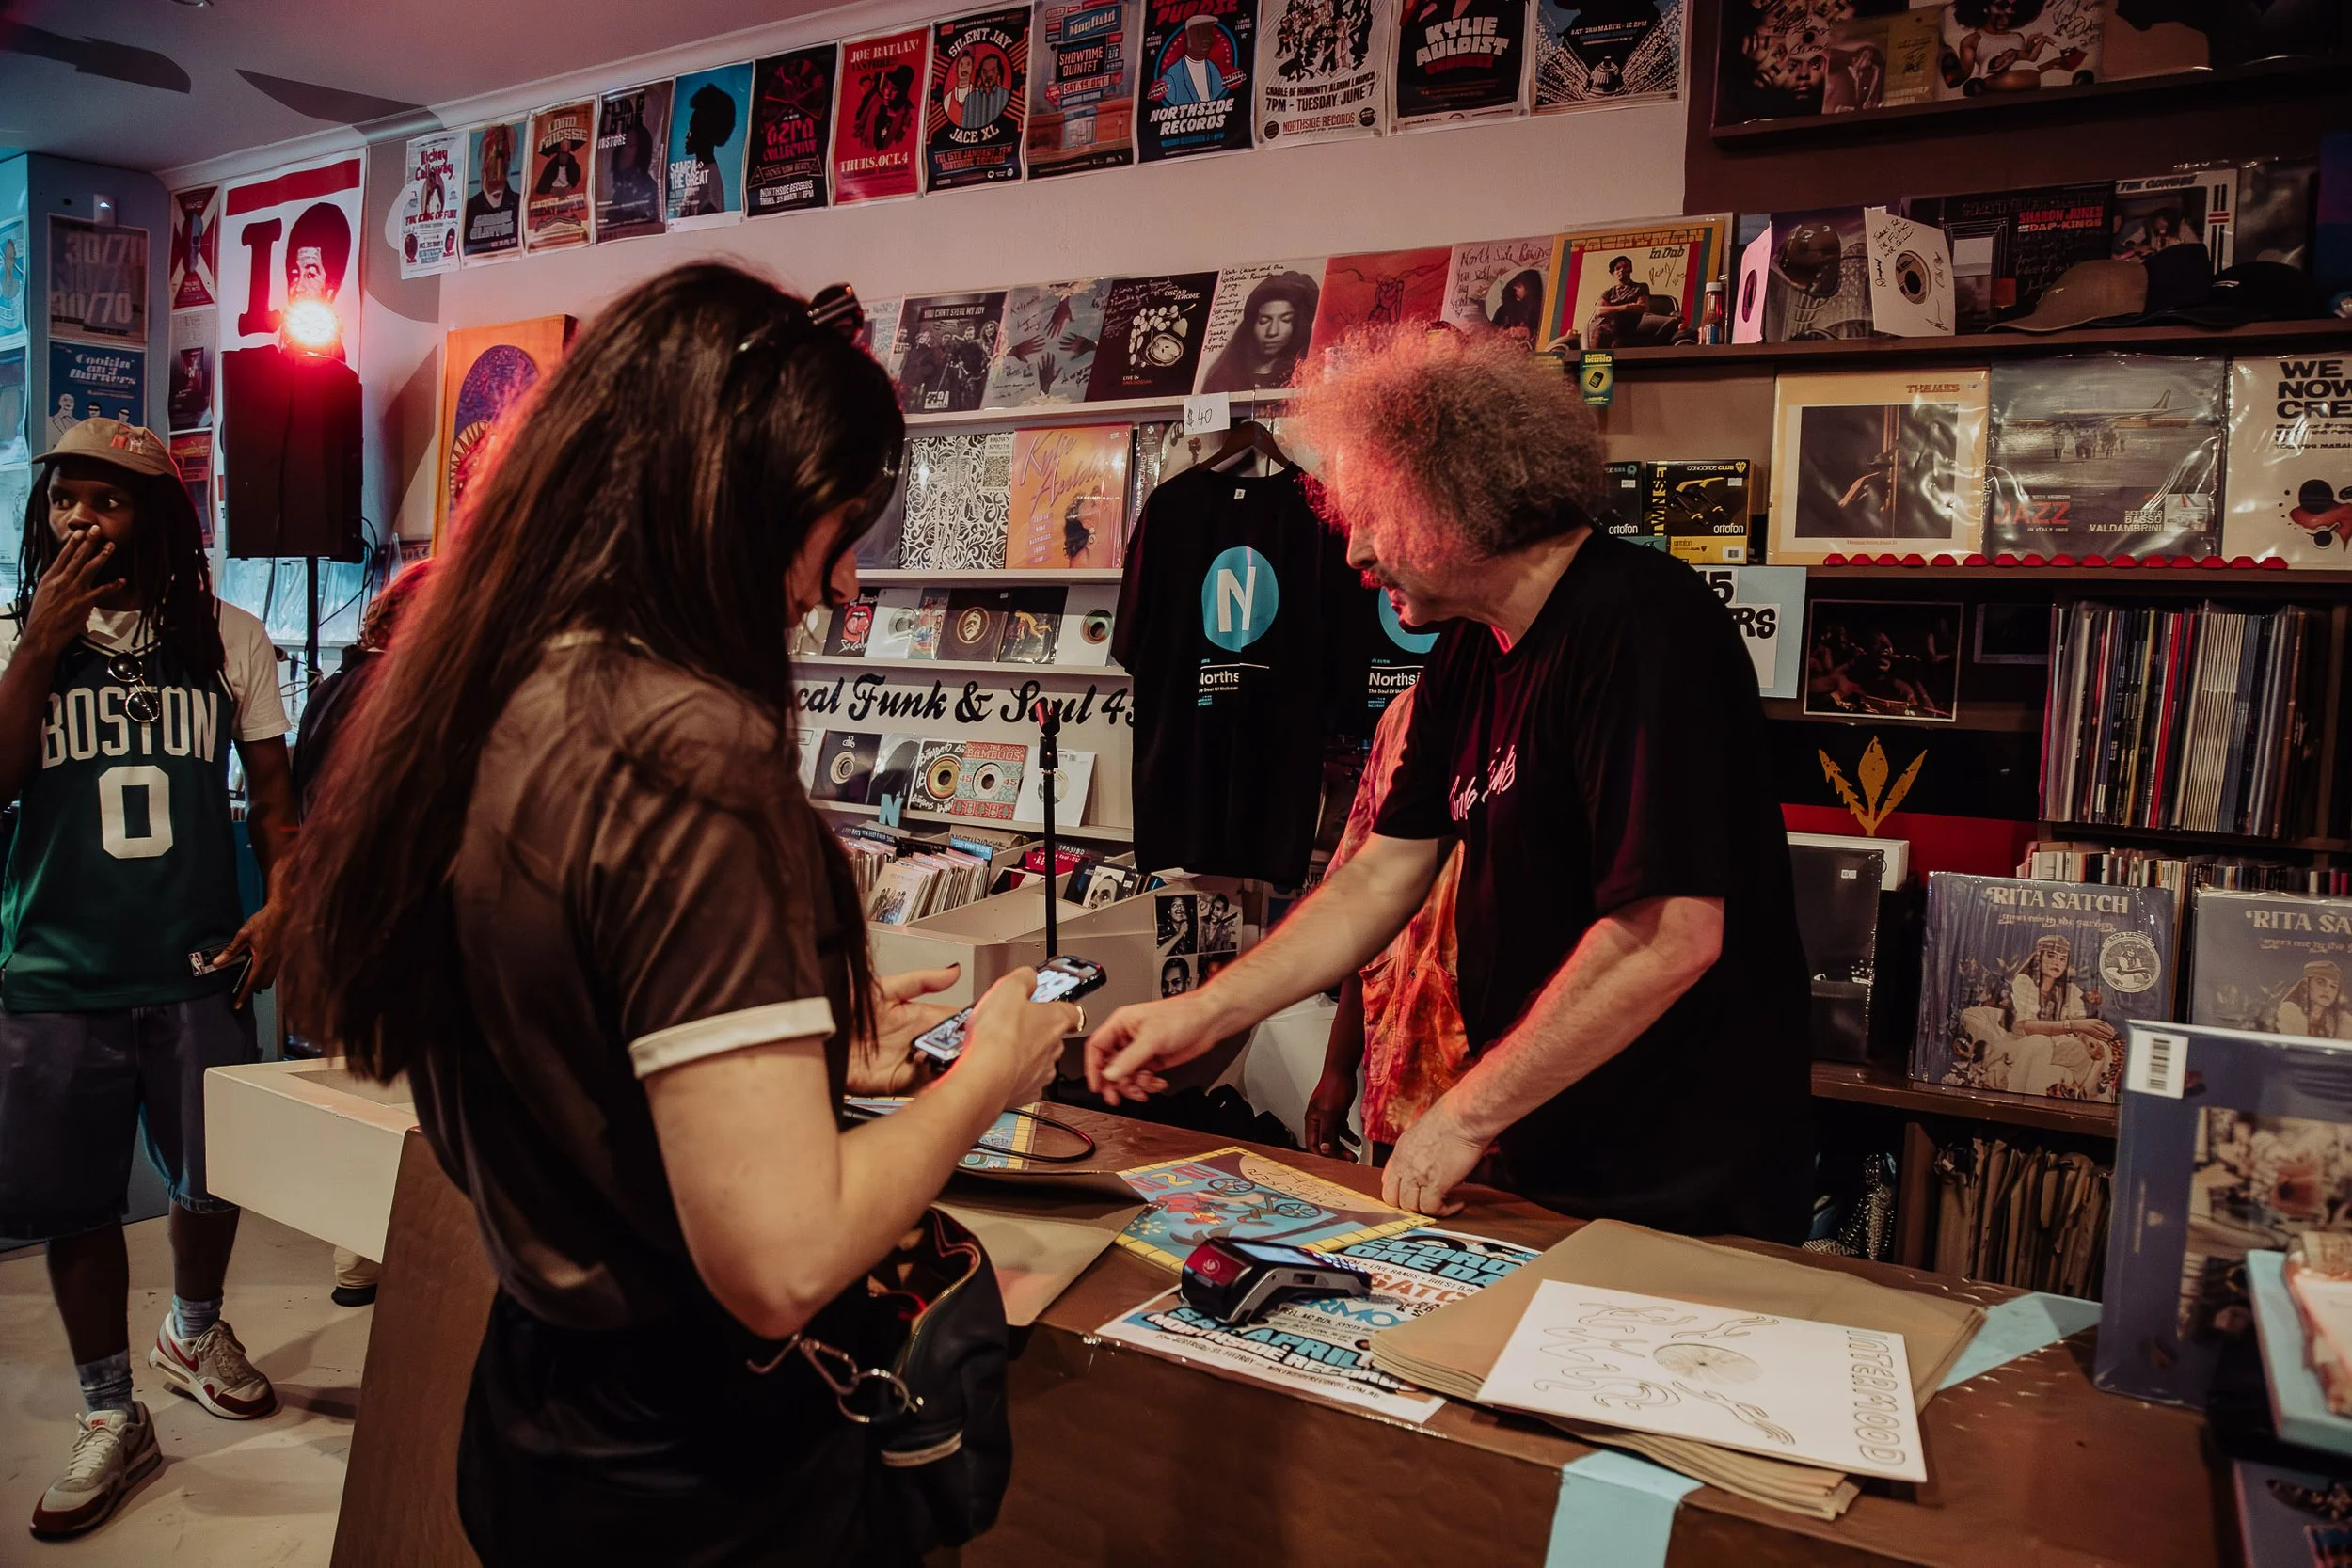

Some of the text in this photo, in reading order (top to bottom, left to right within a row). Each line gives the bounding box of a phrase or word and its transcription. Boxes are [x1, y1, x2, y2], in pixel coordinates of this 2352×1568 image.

[1425, 16, 1498, 45] KYLIE
[948, 27, 1013, 57] SILENT JAY
[1416, 36, 1509, 67] AULDIST
[850, 47, 870, 64] JOE
[1059, 46, 1104, 66] SHOWTIME
[1062, 60, 1099, 77] QUINTET
[1265, 97, 1286, 112] 7PM
[1296, 94, 1339, 112] TUESDAY
[1340, 86, 1365, 105] JUNE
[1367, 82, 1375, 96] 7
[1328, 80, 1350, 94] ALBUM
[1150, 98, 1234, 122] NORTHSIDE
[1159, 115, 1226, 135] RECORDS
[1283, 112, 1355, 133] NORTHSIDE RECORDS
[538, 128, 589, 153] FINESSE
[949, 123, 1000, 144] JACE XL
[669, 159, 697, 174] SAMPA
[685, 169, 710, 187] GREAT
[2018, 206, 2104, 225] SHARON JONES
[2029, 218, 2102, 232] DAP-KINGS
[1649, 246, 1685, 259] In Dub
[1164, 289, 1187, 297] OSCAR
[2280, 360, 2343, 379] WE
[1020, 431, 1077, 486] Kylie
[1993, 501, 2070, 525] JAZZ
[1608, 524, 1639, 535] ortofon
[1713, 523, 1744, 535] ortofon
[2089, 524, 2163, 532] VALDAMBRINI
[1216, 566, 1257, 633] N
[1368, 672, 1421, 687] Northsi
[798, 676, 846, 714] cal
[848, 673, 948, 721] Funk
[954, 680, 993, 724] &
[967, 749, 1022, 761] BAMBOOS
[1003, 778, 1018, 786] 45
[99, 765, 173, 860] 0
[879, 793, 904, 829] N
[1986, 887, 2129, 914] RITA SATCH
[2245, 910, 2312, 931] RITA
[1344, 1244, 1504, 1288] ORE DA
[1361, 1235, 1522, 1276] ECORD
[1391, 1269, 1419, 1280] BANDS
[1145, 1313, 1288, 1362] NORTHSIDE
[1241, 1327, 1362, 1370] APRIL
